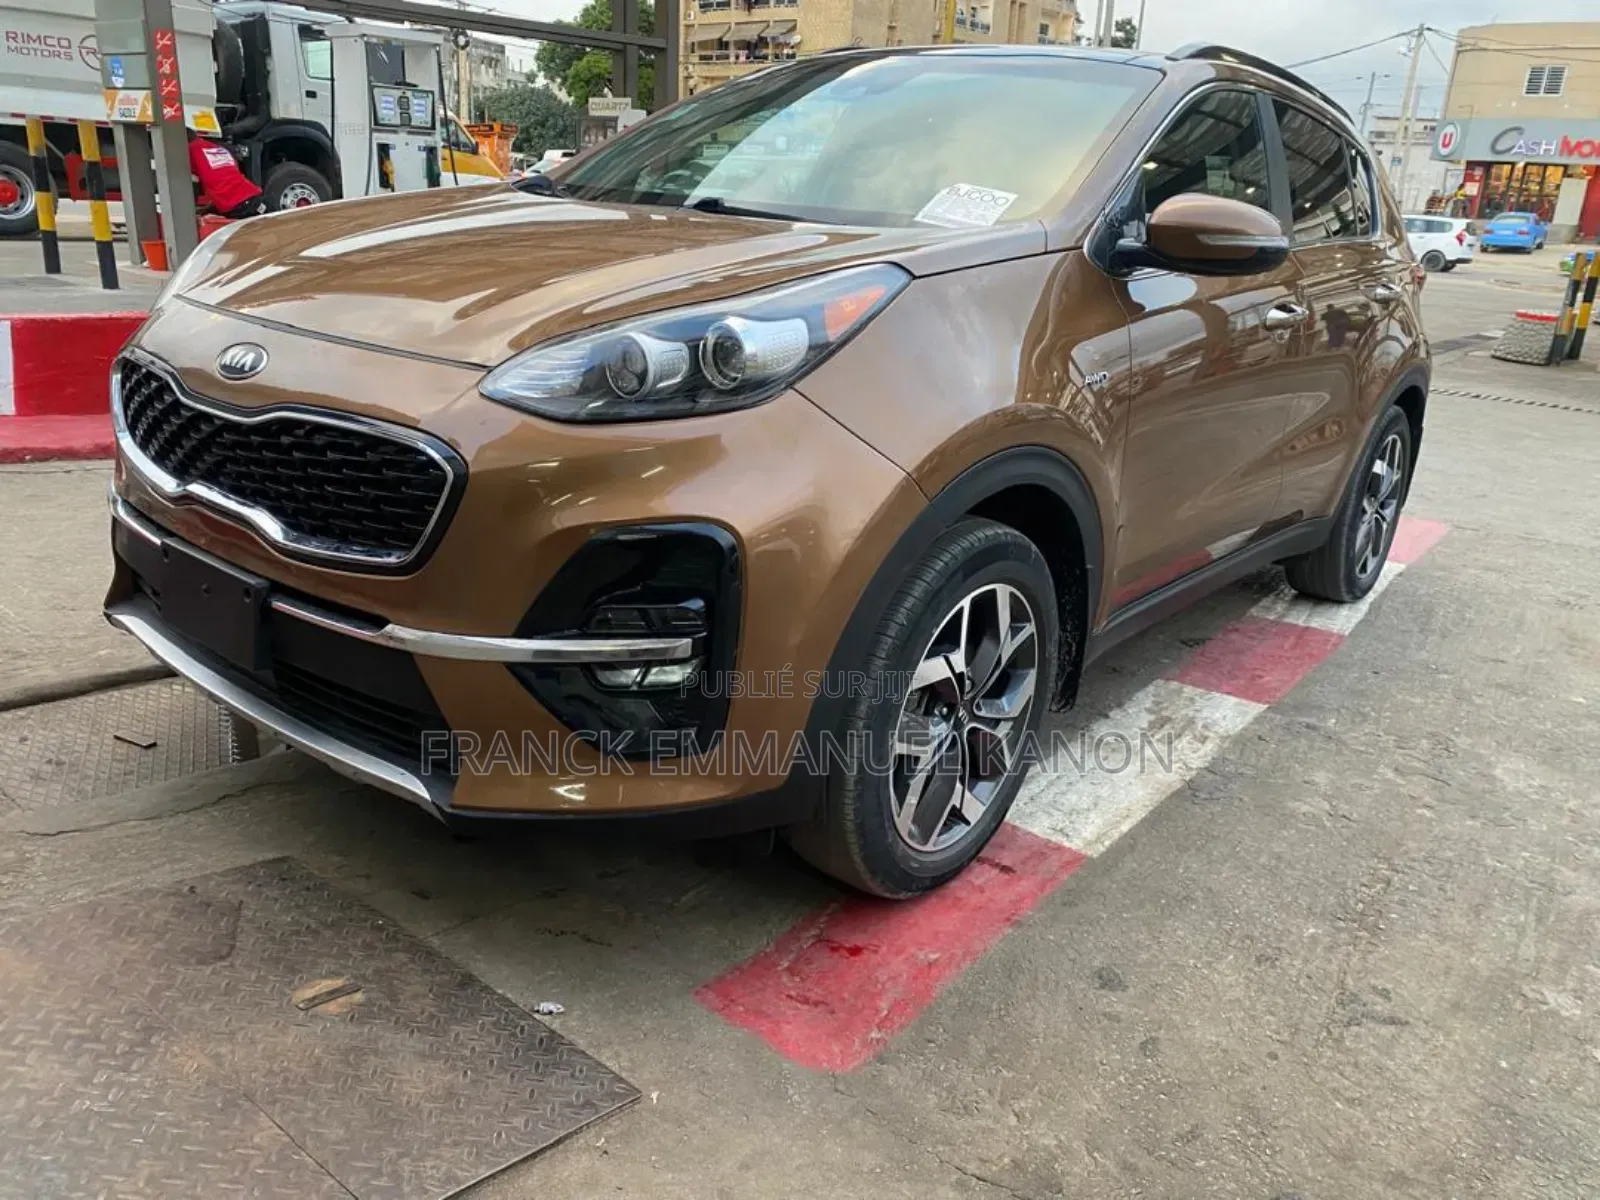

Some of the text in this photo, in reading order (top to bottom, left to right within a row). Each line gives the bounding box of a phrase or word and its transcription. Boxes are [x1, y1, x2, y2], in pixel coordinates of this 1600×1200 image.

[5, 30, 72, 50] RIMCO
[6, 45, 74, 61] MOTORS
[1441, 132, 1454, 149] U
[220, 346, 256, 372] KIA
[1085, 371, 1109, 386] AWD
